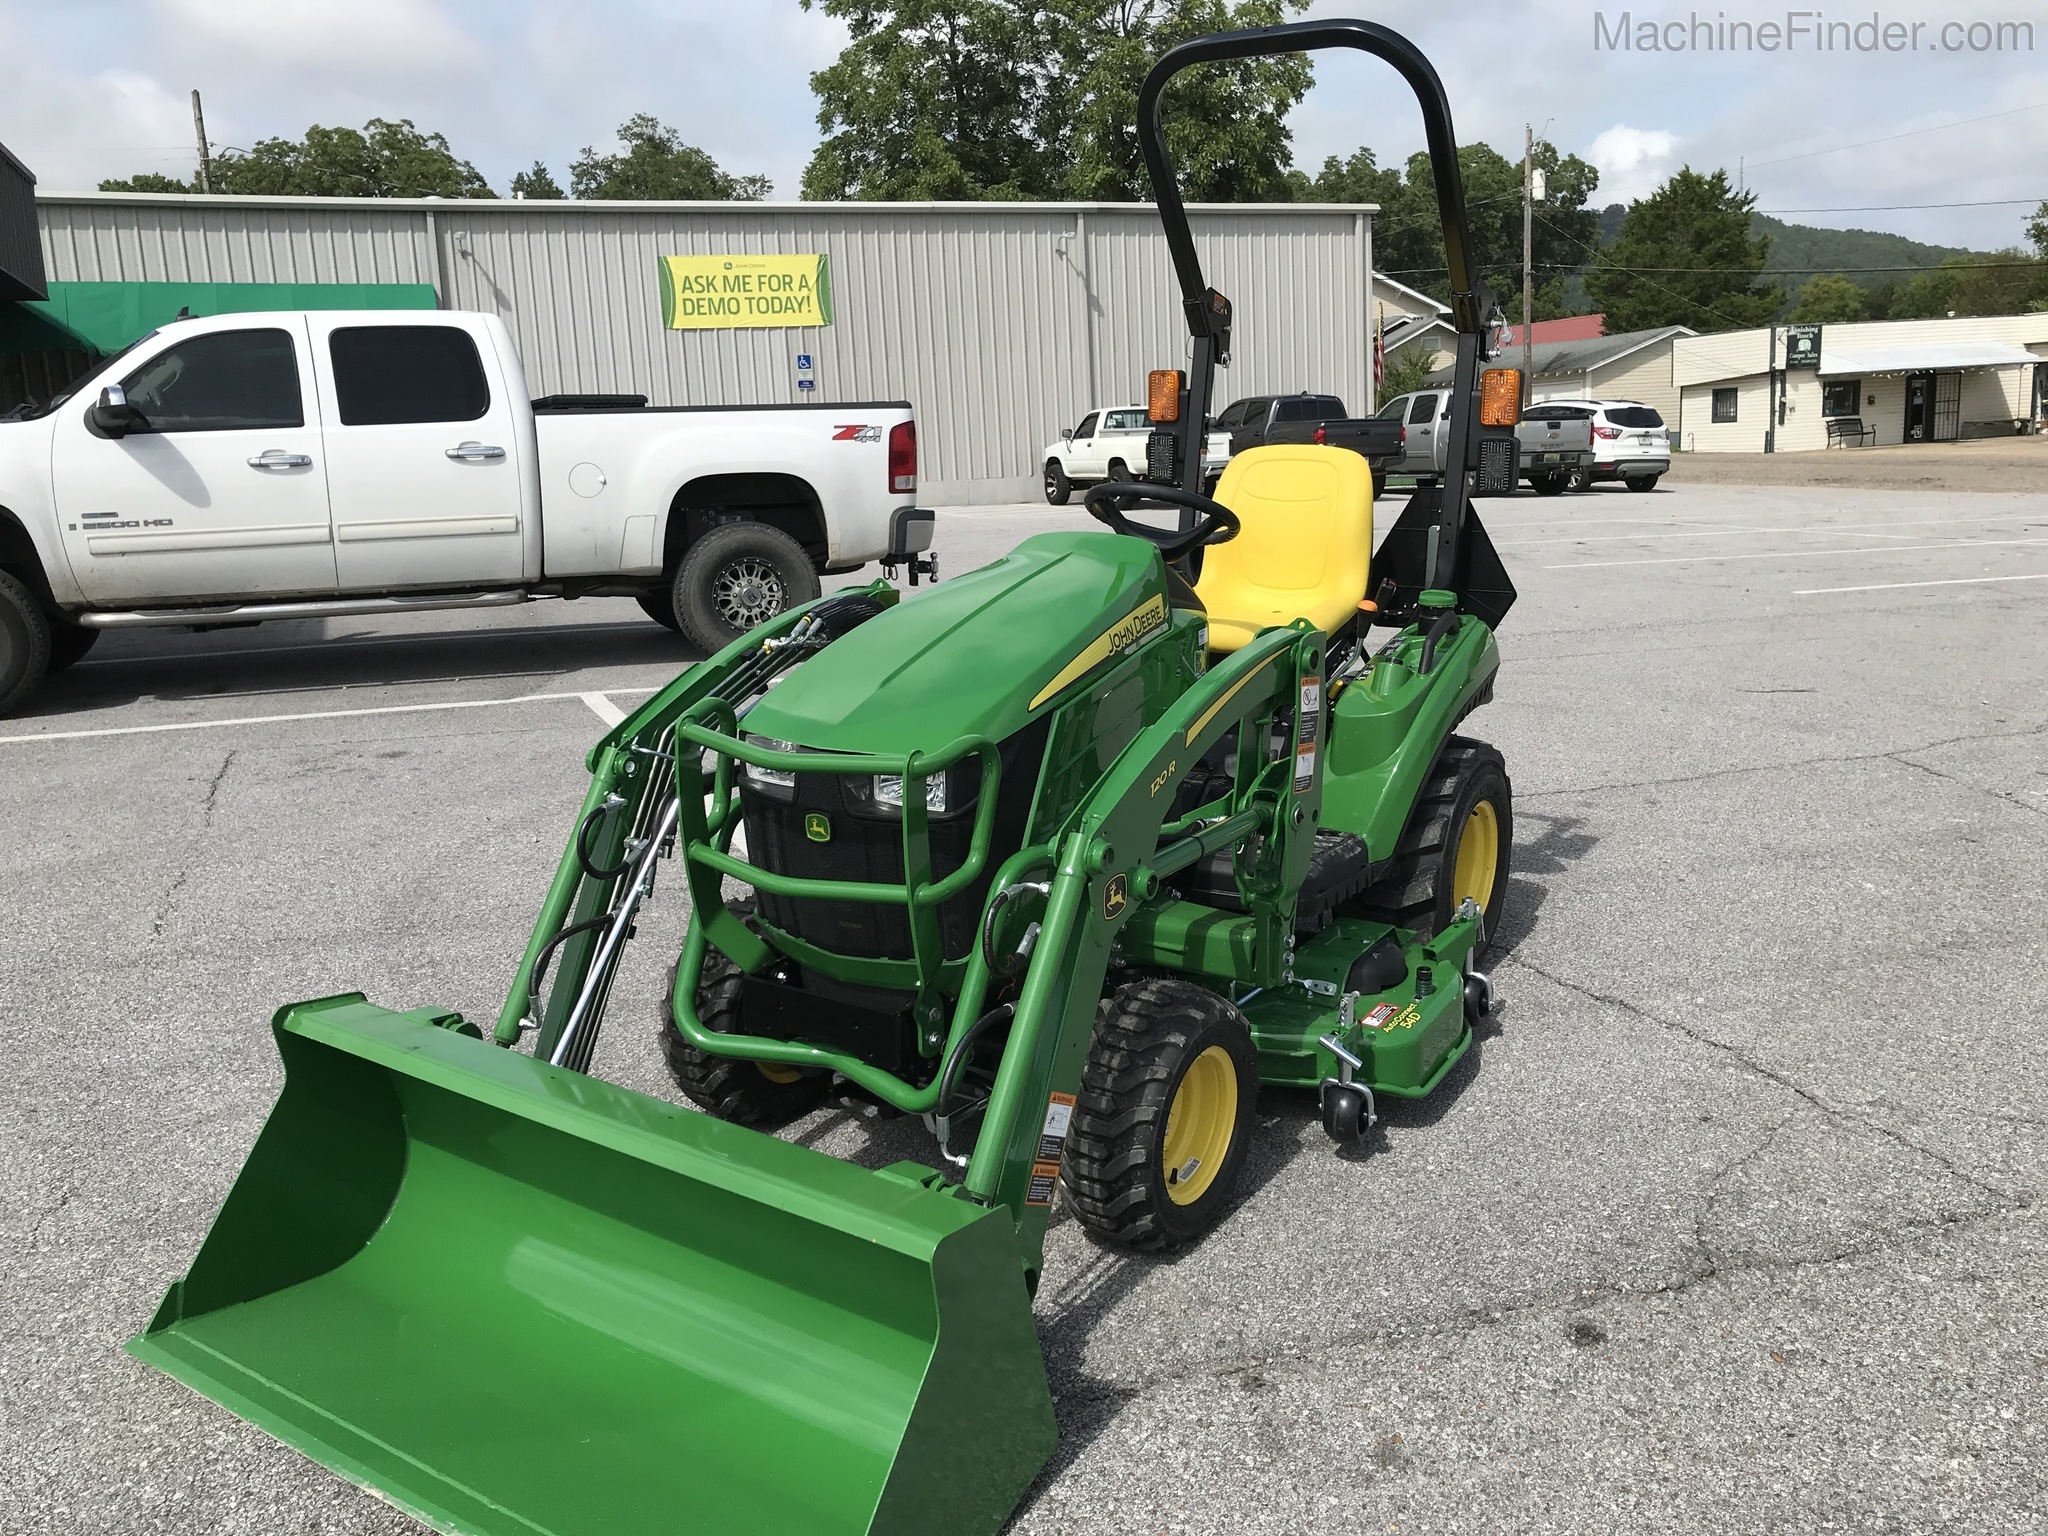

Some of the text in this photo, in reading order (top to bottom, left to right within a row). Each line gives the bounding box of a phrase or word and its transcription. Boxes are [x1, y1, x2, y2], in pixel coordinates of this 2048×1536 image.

[682, 274, 811, 294] ASK ME FOR A
[683, 295, 812, 316] DEMO TODAY!
[1109, 623, 1134, 654] JOHN
[1132, 605, 1163, 637] DEERE
[1400, 1012, 1421, 1029] 54D
